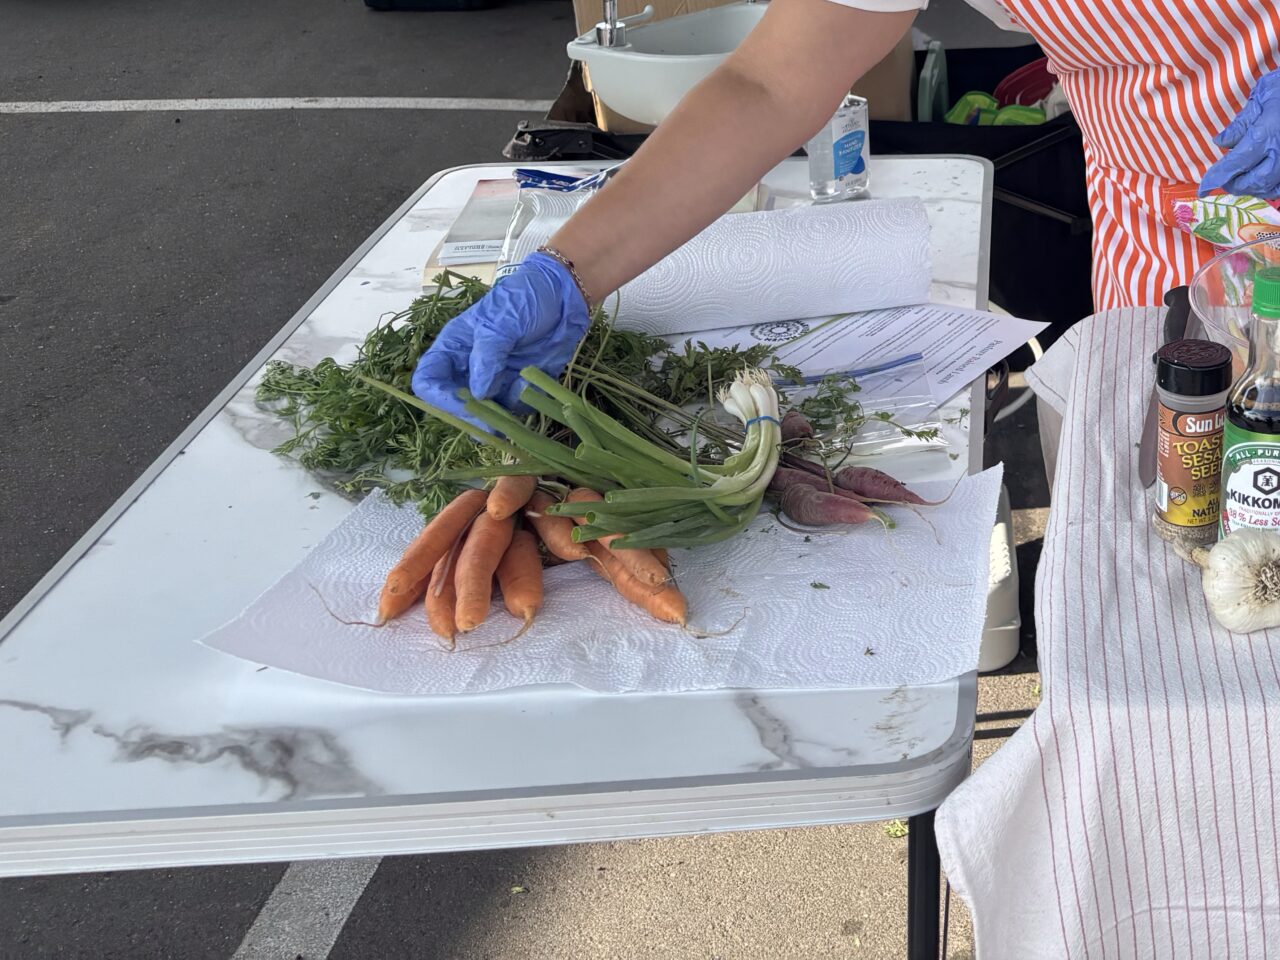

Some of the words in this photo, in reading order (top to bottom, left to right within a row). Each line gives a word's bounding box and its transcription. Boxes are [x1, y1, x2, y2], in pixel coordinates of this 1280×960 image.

[1186, 416, 1212, 433] Sun
[1191, 462, 1222, 480] SEE
[1248, 515, 1268, 526] Less
